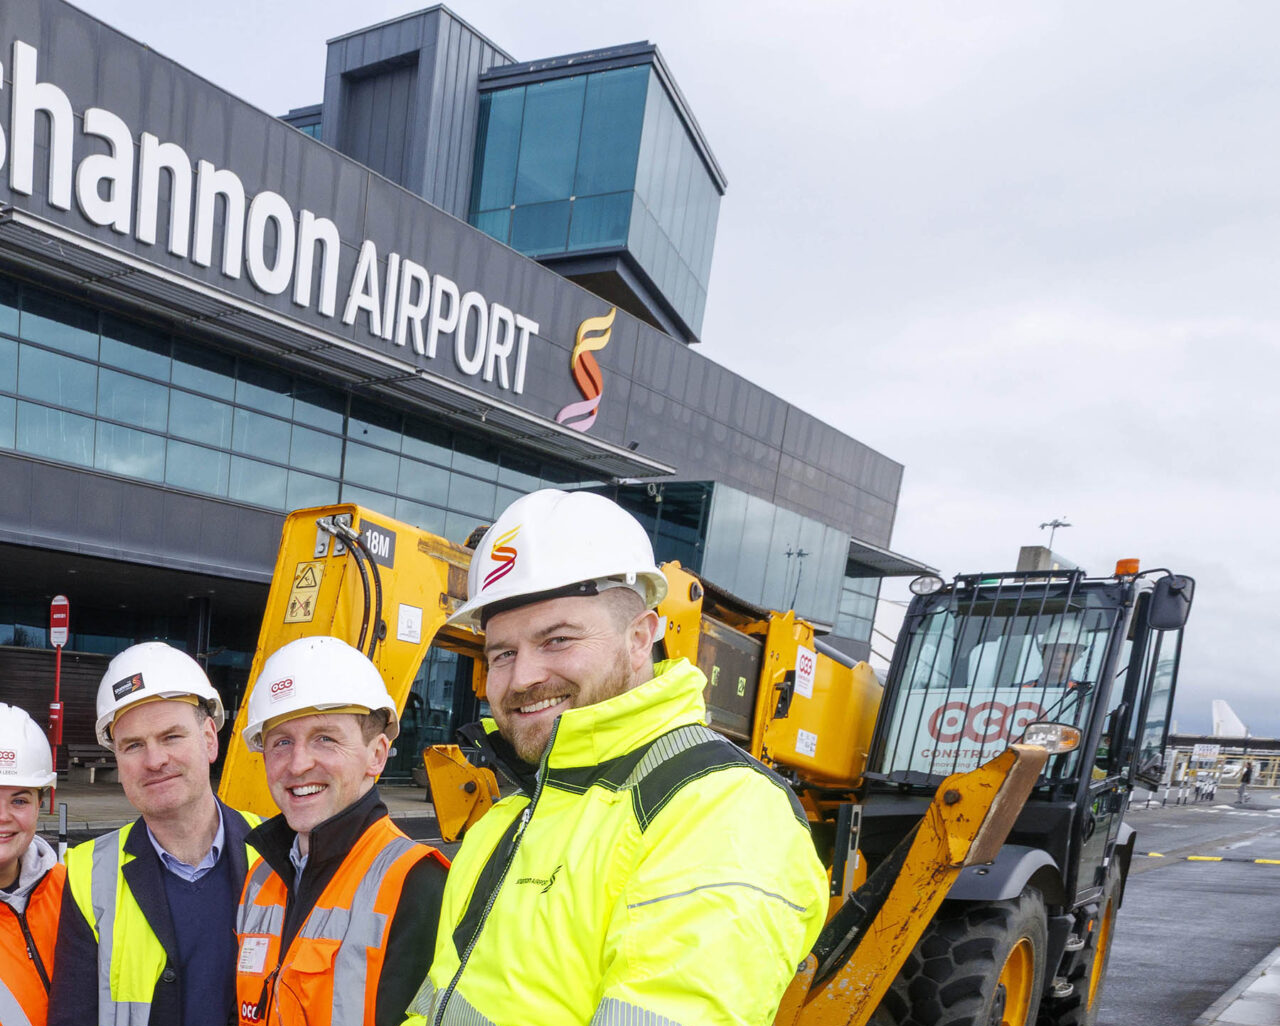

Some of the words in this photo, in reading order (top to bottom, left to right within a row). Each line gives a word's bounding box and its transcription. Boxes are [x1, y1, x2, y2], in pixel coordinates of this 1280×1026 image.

[342, 240, 539, 394] AIRPORT
[366, 529, 390, 558] 18M
[271, 679, 293, 693] OCC
[921, 749, 1003, 759] CONSTRUC
